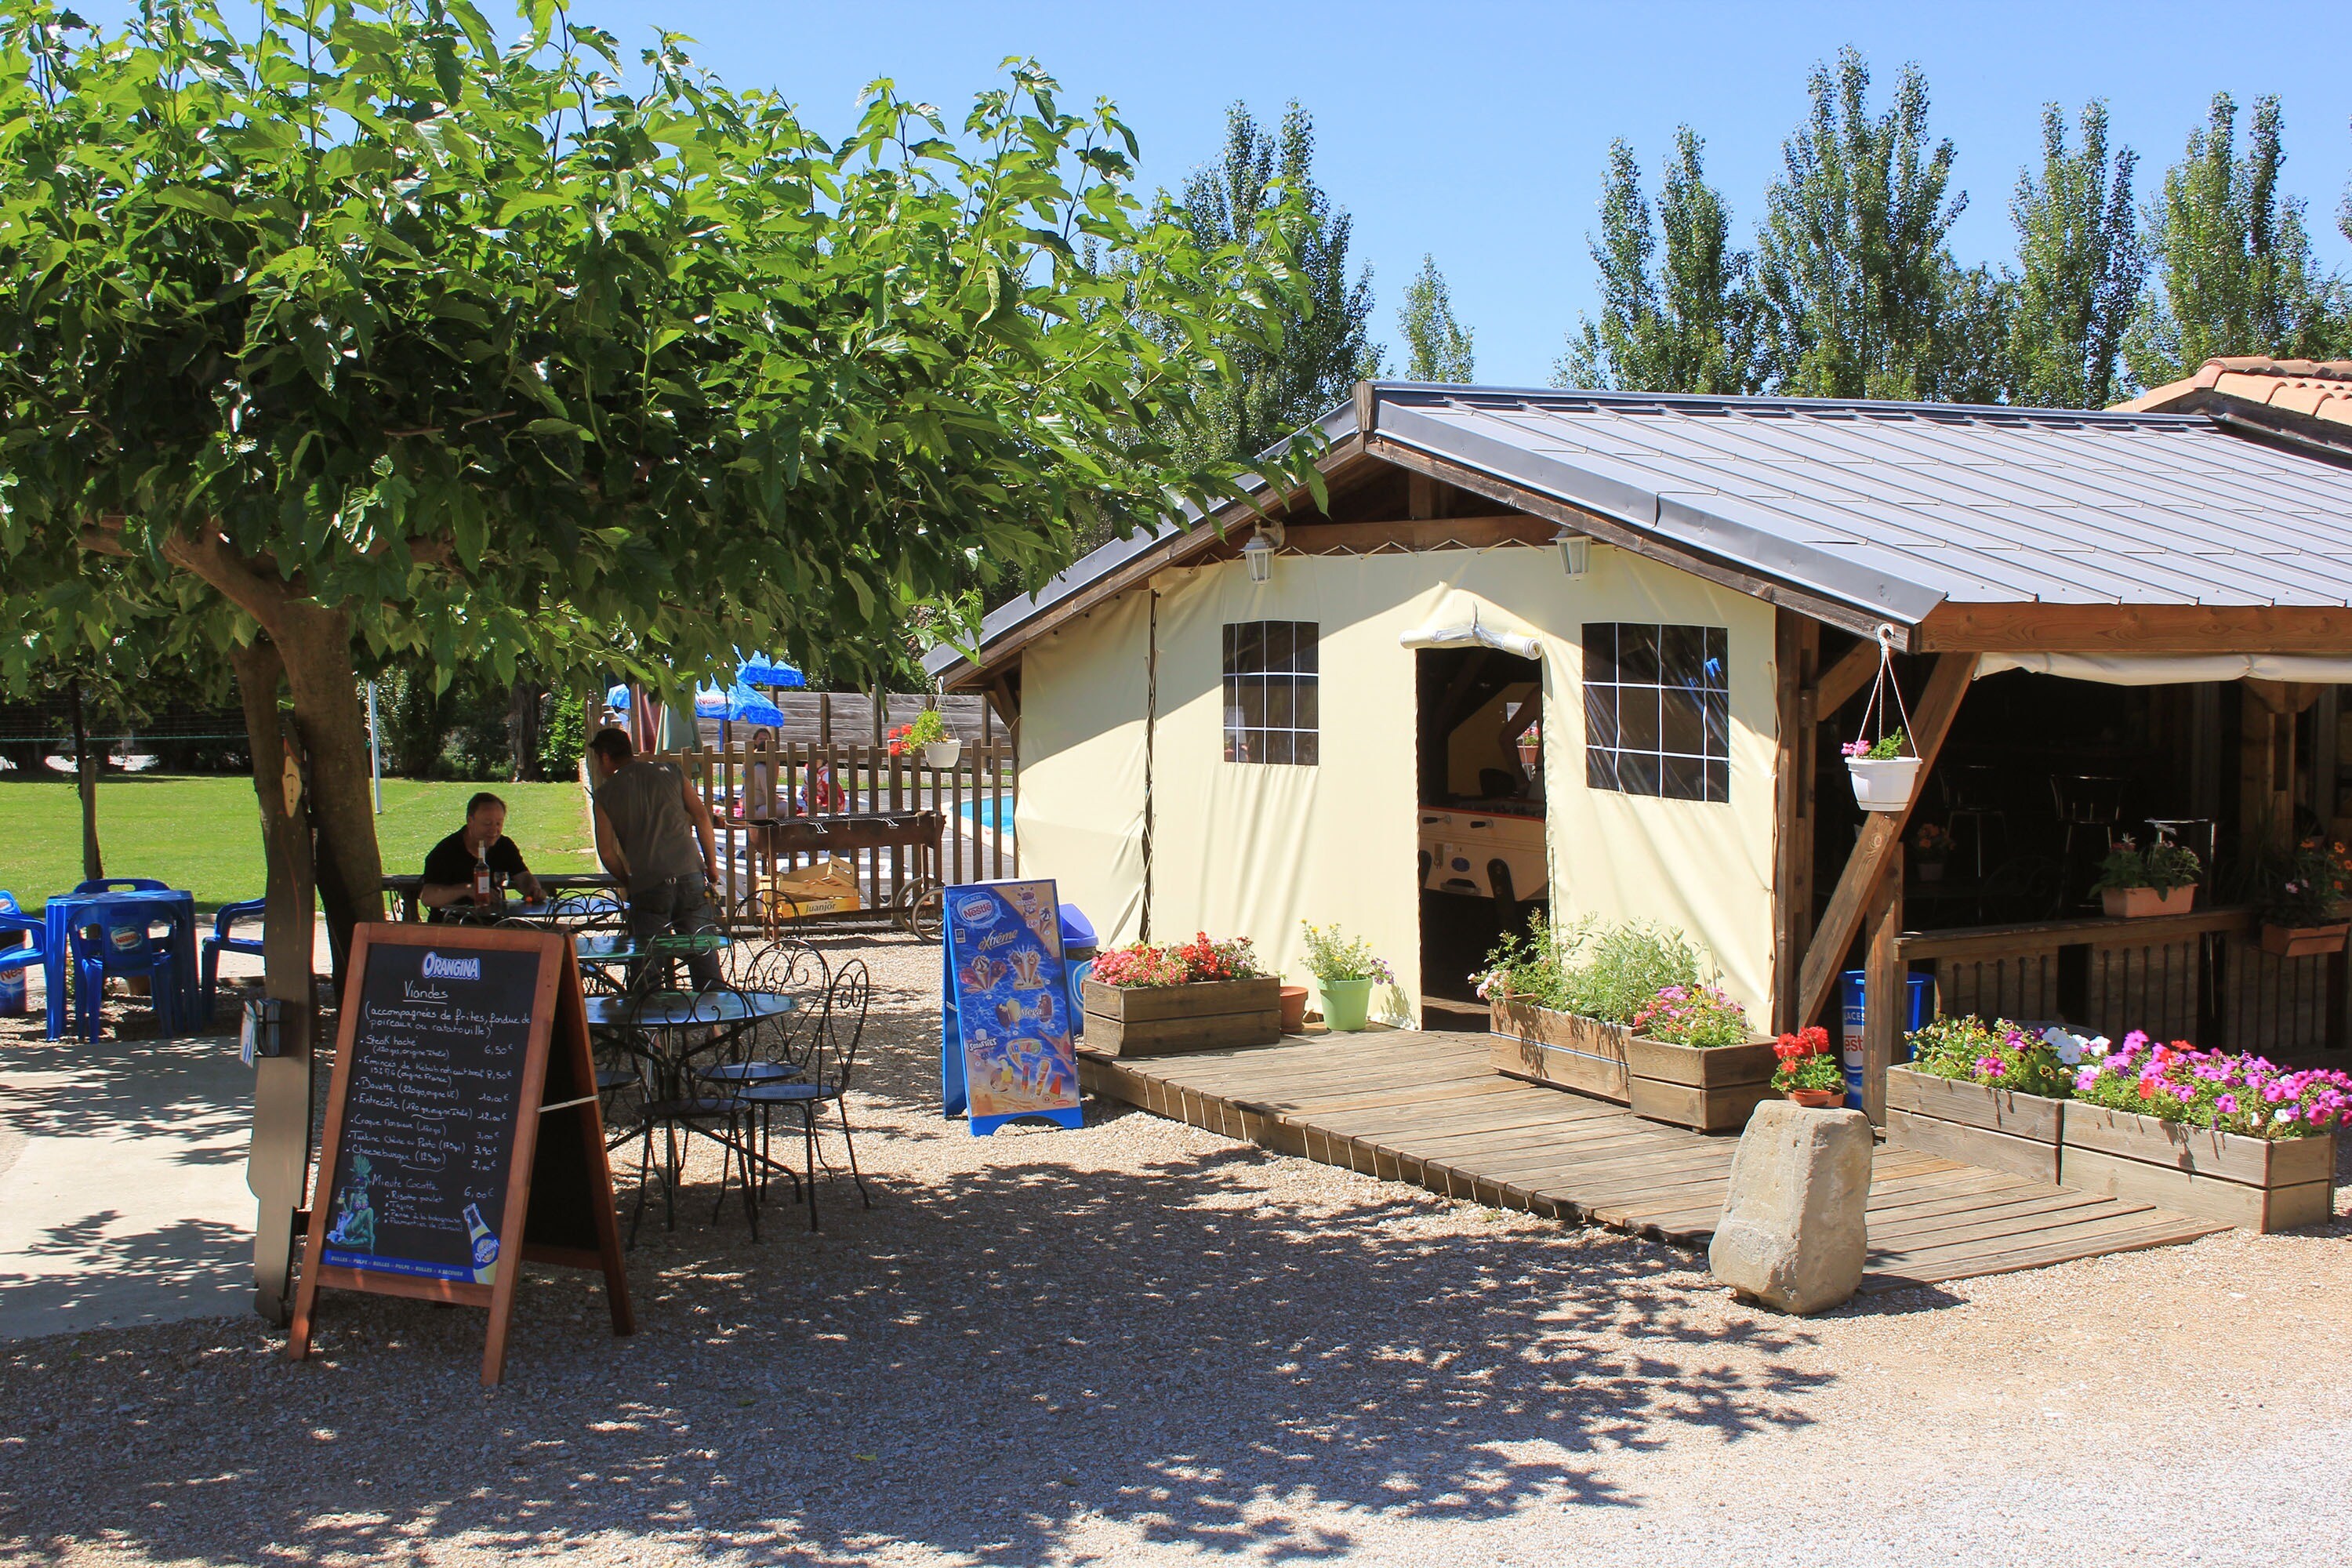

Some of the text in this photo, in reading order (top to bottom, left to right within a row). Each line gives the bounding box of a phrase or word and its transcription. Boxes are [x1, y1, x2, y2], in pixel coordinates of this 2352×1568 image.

[964, 902, 992, 918] Nestlé
[441, 1010, 452, 1020] de
[521, 1013, 532, 1025] de
[1844, 1011, 1865, 1022] LACES
[369, 1019, 412, 1030] poireaux
[1844, 1035, 1864, 1052] est
[401, 1060, 412, 1069] de
[354, 1113, 382, 1127] Croque
[350, 1130, 381, 1142] Tartine
[417, 1137, 436, 1149] Pesto
